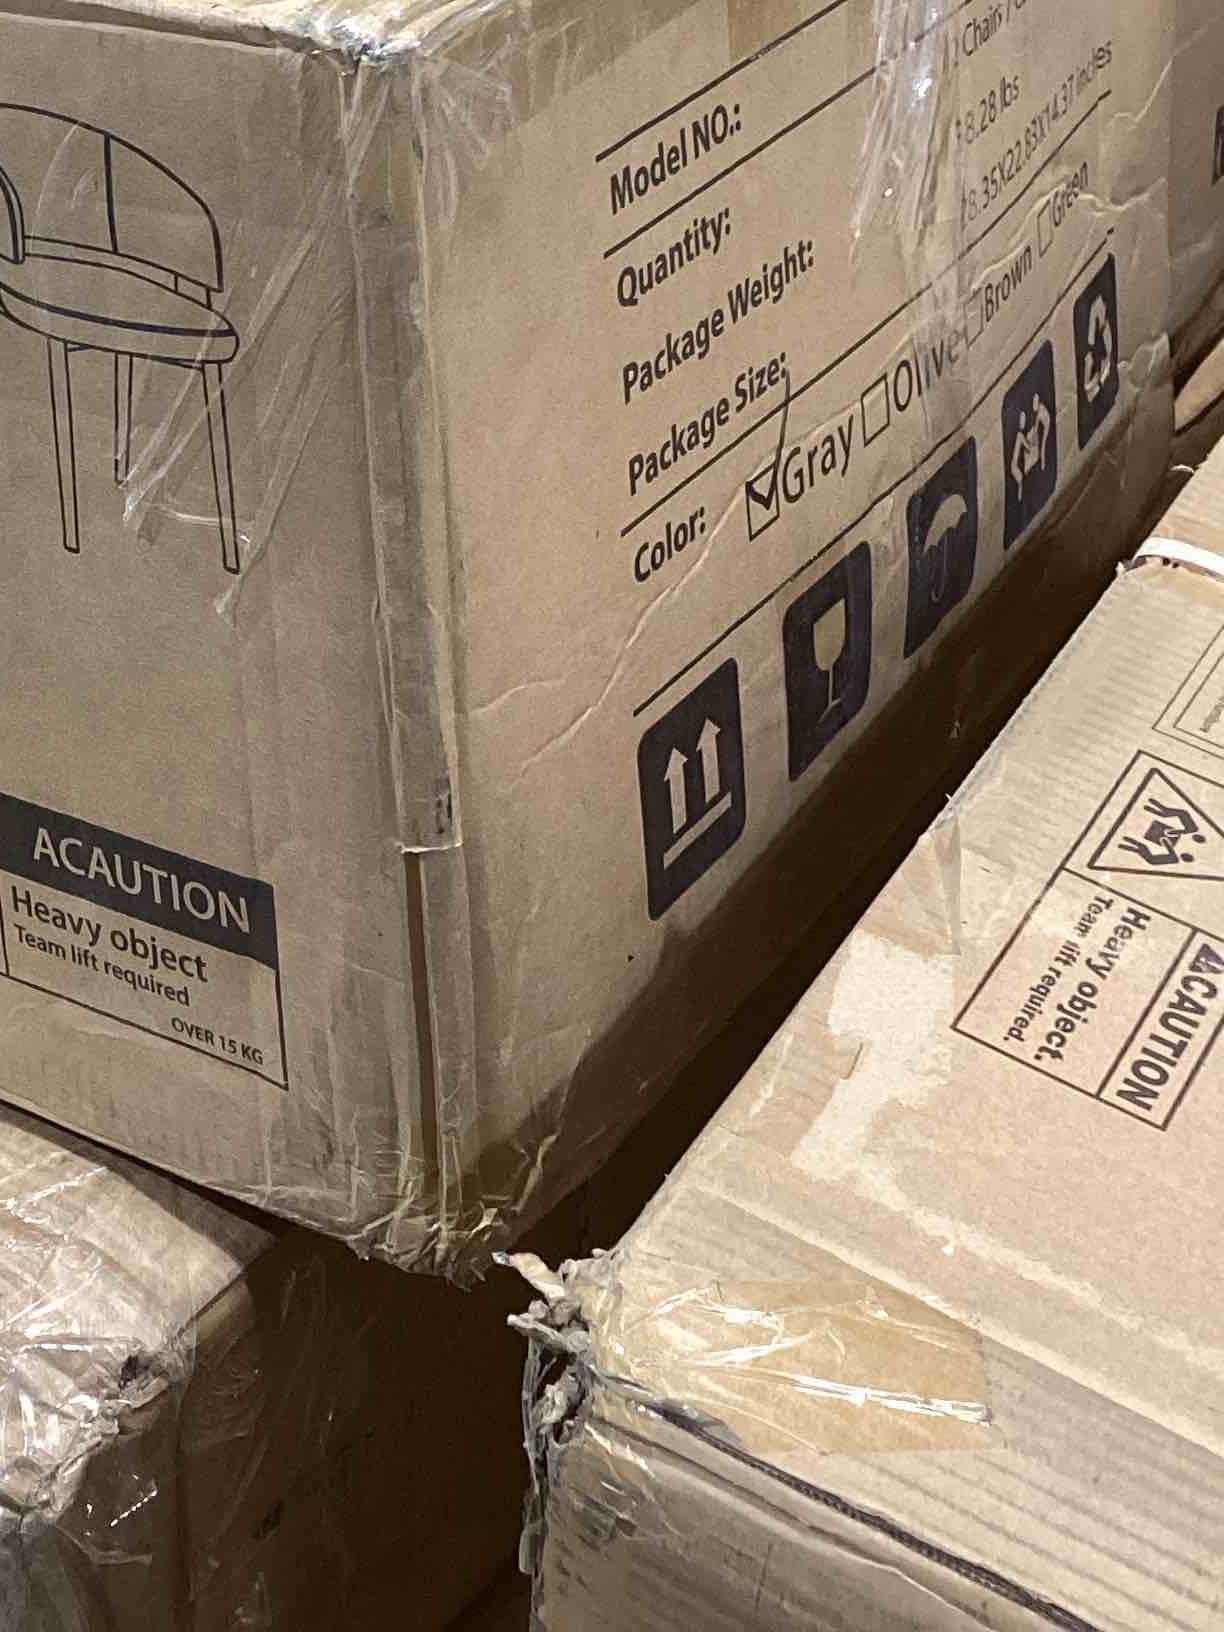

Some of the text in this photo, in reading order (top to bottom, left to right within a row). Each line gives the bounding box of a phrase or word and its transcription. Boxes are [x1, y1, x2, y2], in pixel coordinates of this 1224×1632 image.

[610, 127, 688, 215] Model
[617, 208, 731, 307] Quantity:
[623, 308, 724, 406] Package
[728, 240, 815, 324] Weight:
[634, 161, 1090, 583] Color: Gray Olive Brown Green
[629, 397, 729, 497] Package
[734, 352, 787, 413] Size:
[33, 827, 251, 934] ACAUTION
[1073, 896, 1115, 938] Team
[11, 885, 209, 983] Heavy object
[13, 923, 191, 1007] Team lift required
[1003, 966, 1063, 1042] required.
[1033, 907, 1152, 1061] Heavy object.
[171, 1017, 264, 1066] OVER 15 KG
